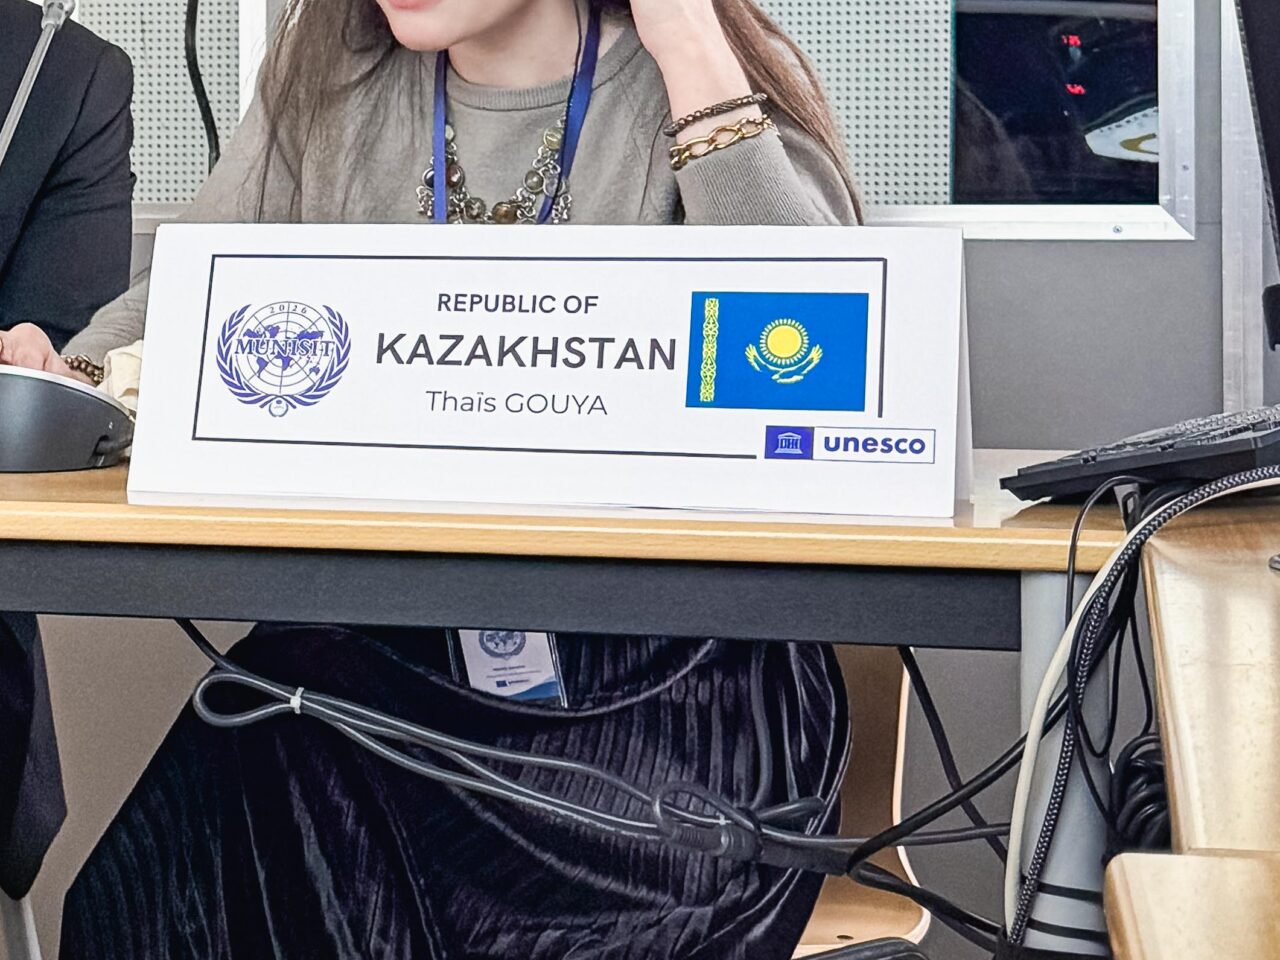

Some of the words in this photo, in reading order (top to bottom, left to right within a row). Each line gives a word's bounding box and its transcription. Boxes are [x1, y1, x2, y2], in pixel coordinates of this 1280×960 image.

[269, 305, 308, 314] 2026
[437, 293, 556, 313] REPUBLIC
[563, 295, 599, 314] OF
[234, 338, 336, 357] MUNISIT
[376, 332, 676, 370] KAZAKHSTAN
[425, 390, 497, 413] Thaïs
[505, 393, 608, 415] GOUYA
[823, 436, 926, 454] unesco
